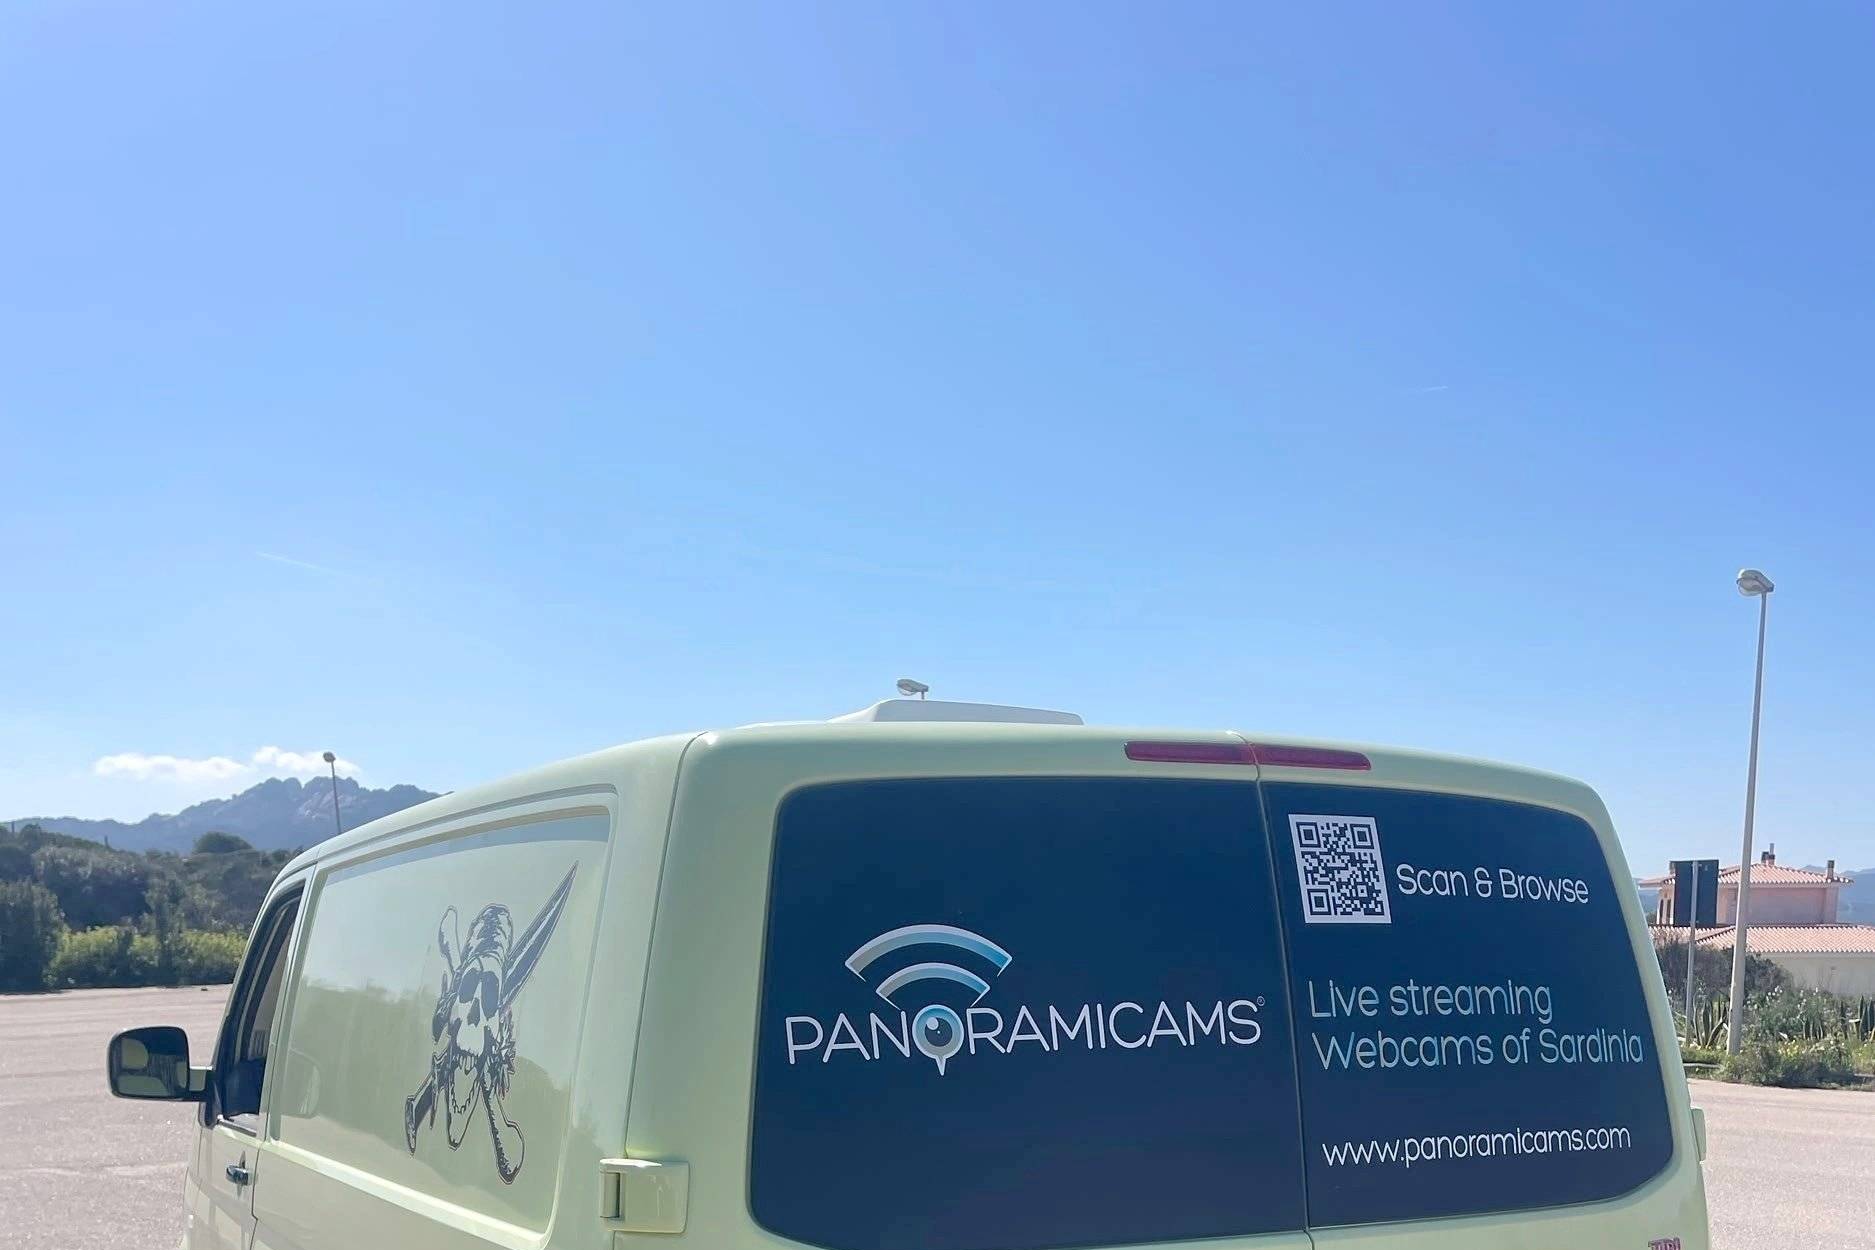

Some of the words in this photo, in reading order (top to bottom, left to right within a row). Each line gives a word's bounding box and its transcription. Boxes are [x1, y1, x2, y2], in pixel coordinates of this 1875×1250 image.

[1396, 863, 1469, 896] Scan
[1474, 866, 1493, 898] &
[1499, 868, 1589, 904] Browse
[1308, 979, 1380, 1018] Live
[1390, 978, 1553, 1025] streaming
[1311, 1030, 1494, 1070] Webcams
[1502, 1028, 1531, 1064] of
[1540, 1028, 1644, 1065] Sardinia
[1322, 1126, 1632, 1169] www.panoramicams.com
